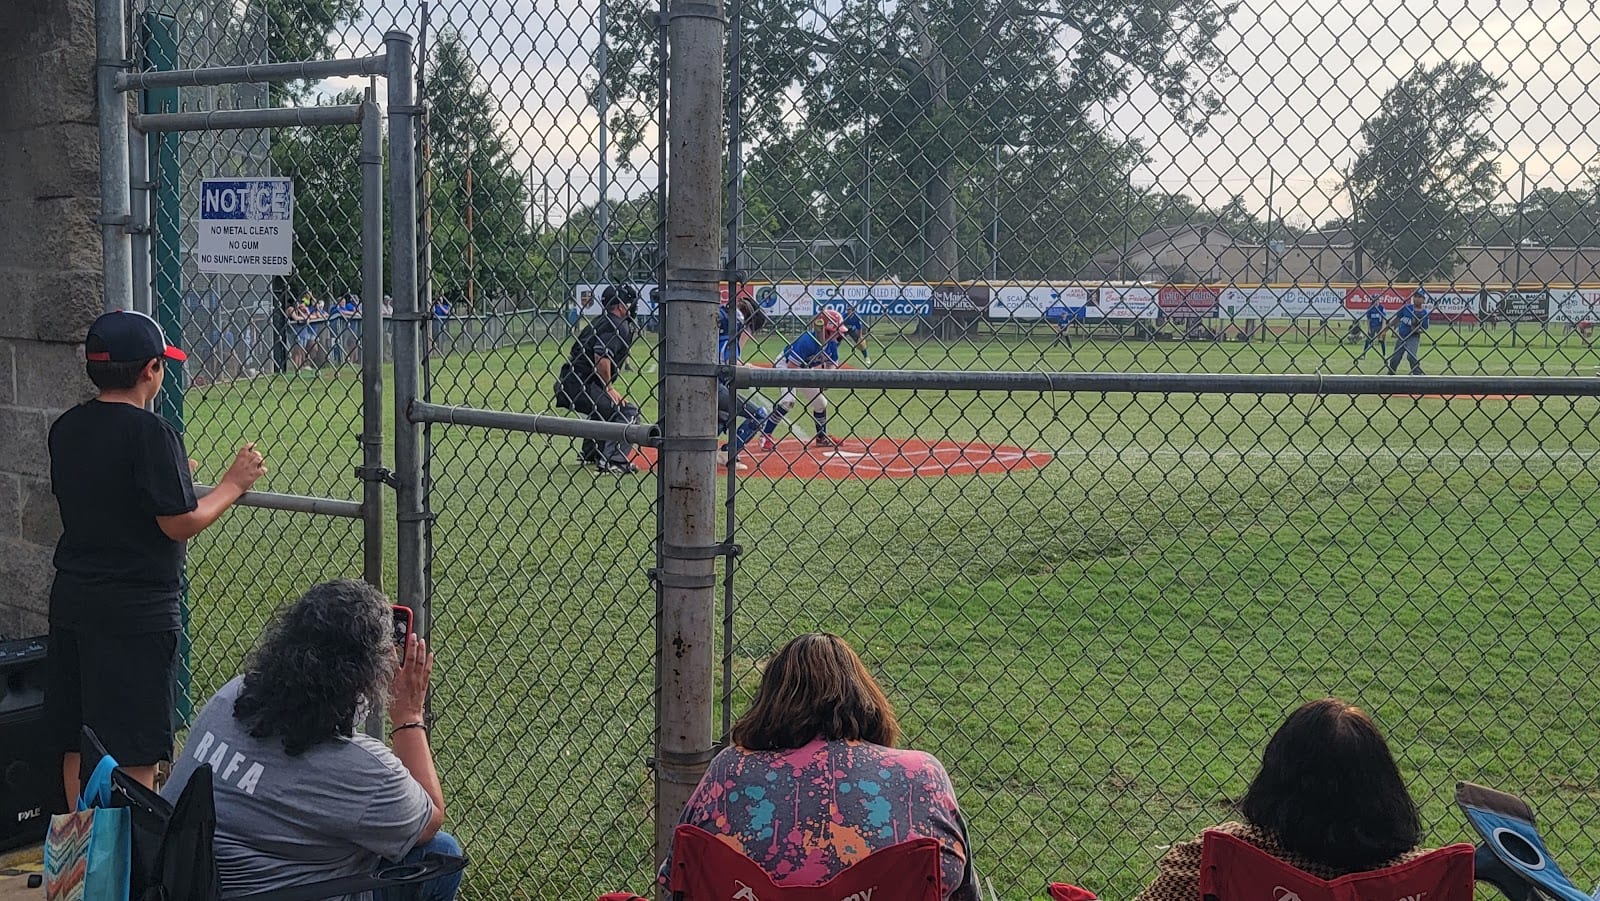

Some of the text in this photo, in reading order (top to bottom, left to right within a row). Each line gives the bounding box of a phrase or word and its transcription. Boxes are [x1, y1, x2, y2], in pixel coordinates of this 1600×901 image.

[205, 188, 286, 213] NOTICE
[210, 226, 279, 235] NO METAL CLEATS
[228, 241, 259, 250] NO GUM
[201, 254, 288, 265] NO SUNFLOWER SEEDS
[825, 288, 845, 297] CI
[847, 287, 889, 298] CONTRLLED
[1006, 302, 1043, 310] COTROS
[1297, 296, 1344, 305] CLANER
[193, 731, 265, 795] RAFA
[18, 806, 42, 822] PYLE
